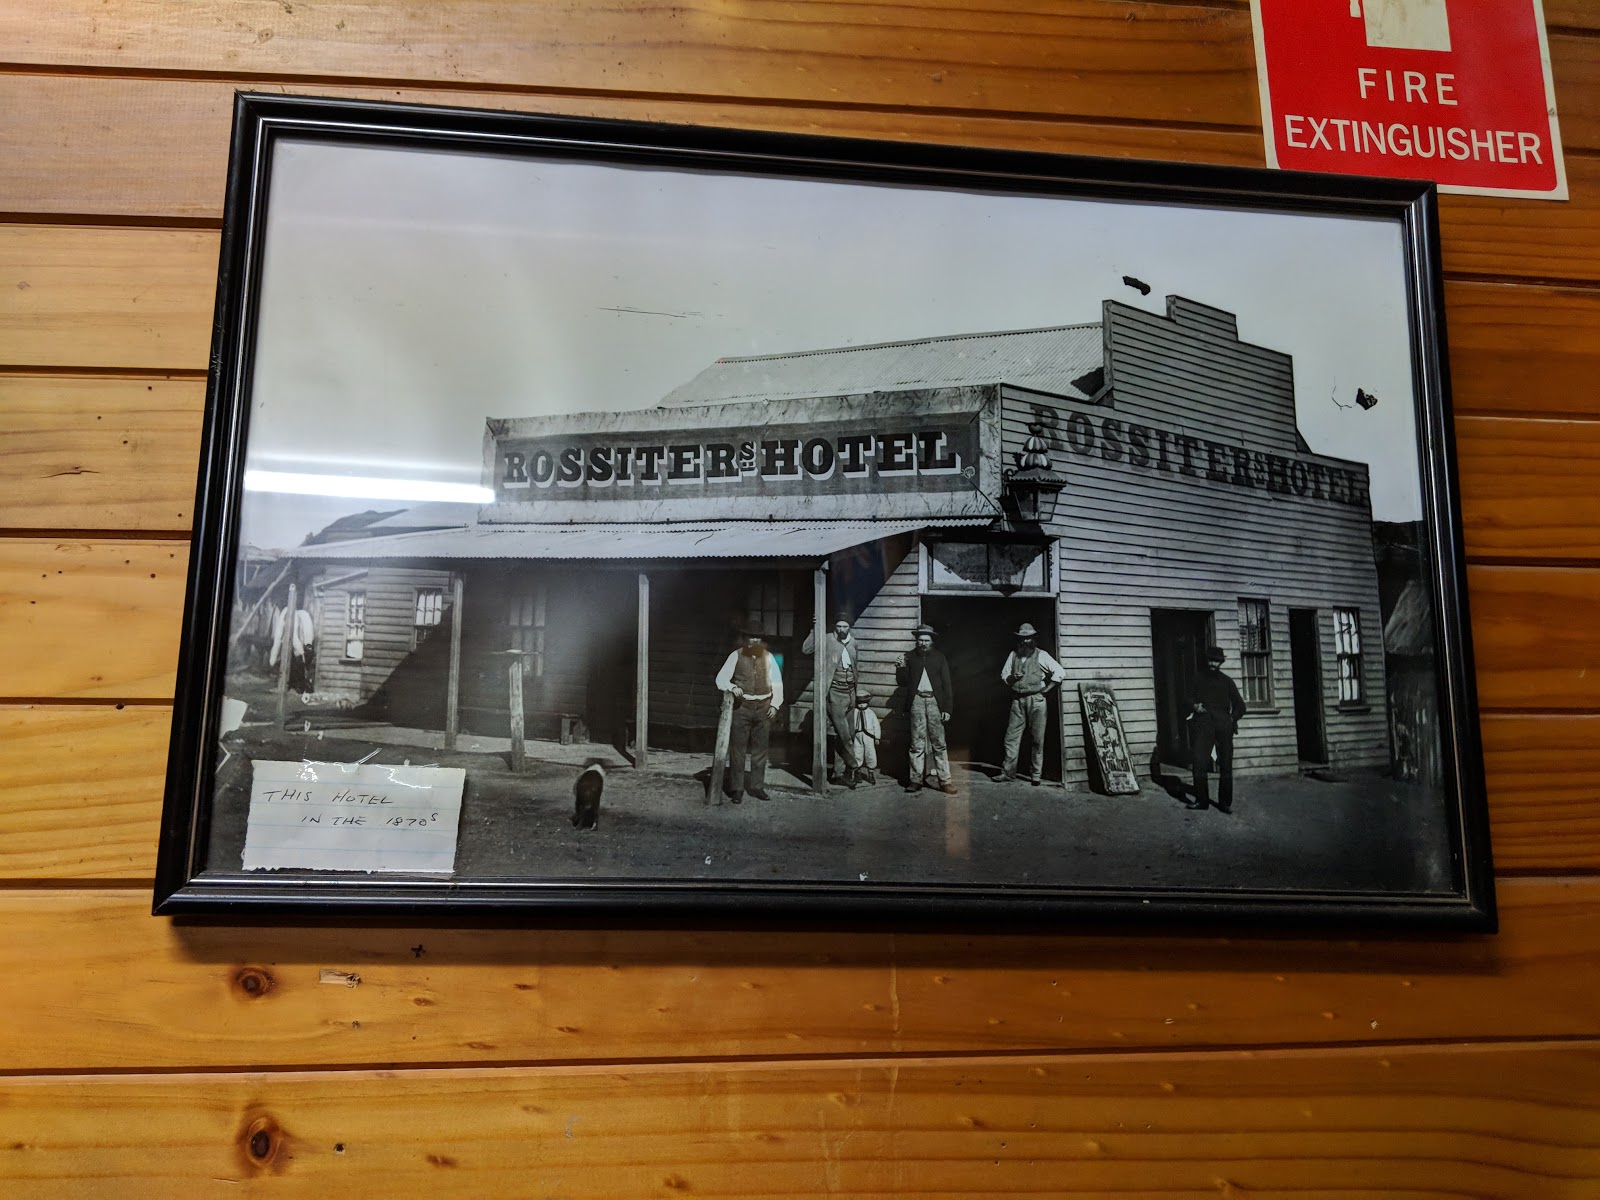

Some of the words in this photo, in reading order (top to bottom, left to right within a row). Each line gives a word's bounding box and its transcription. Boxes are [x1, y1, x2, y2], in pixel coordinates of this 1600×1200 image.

[1357, 67, 1459, 106] FIRE
[1284, 114, 1544, 165] EXTINGUISHER
[761, 431, 962, 482] HOTEL
[1267, 455, 1368, 507] HOTEL
[262, 789, 313, 802] THIS
[332, 789, 395, 805] HOTEL
[301, 814, 321, 824] IN
[332, 815, 367, 825] THE
